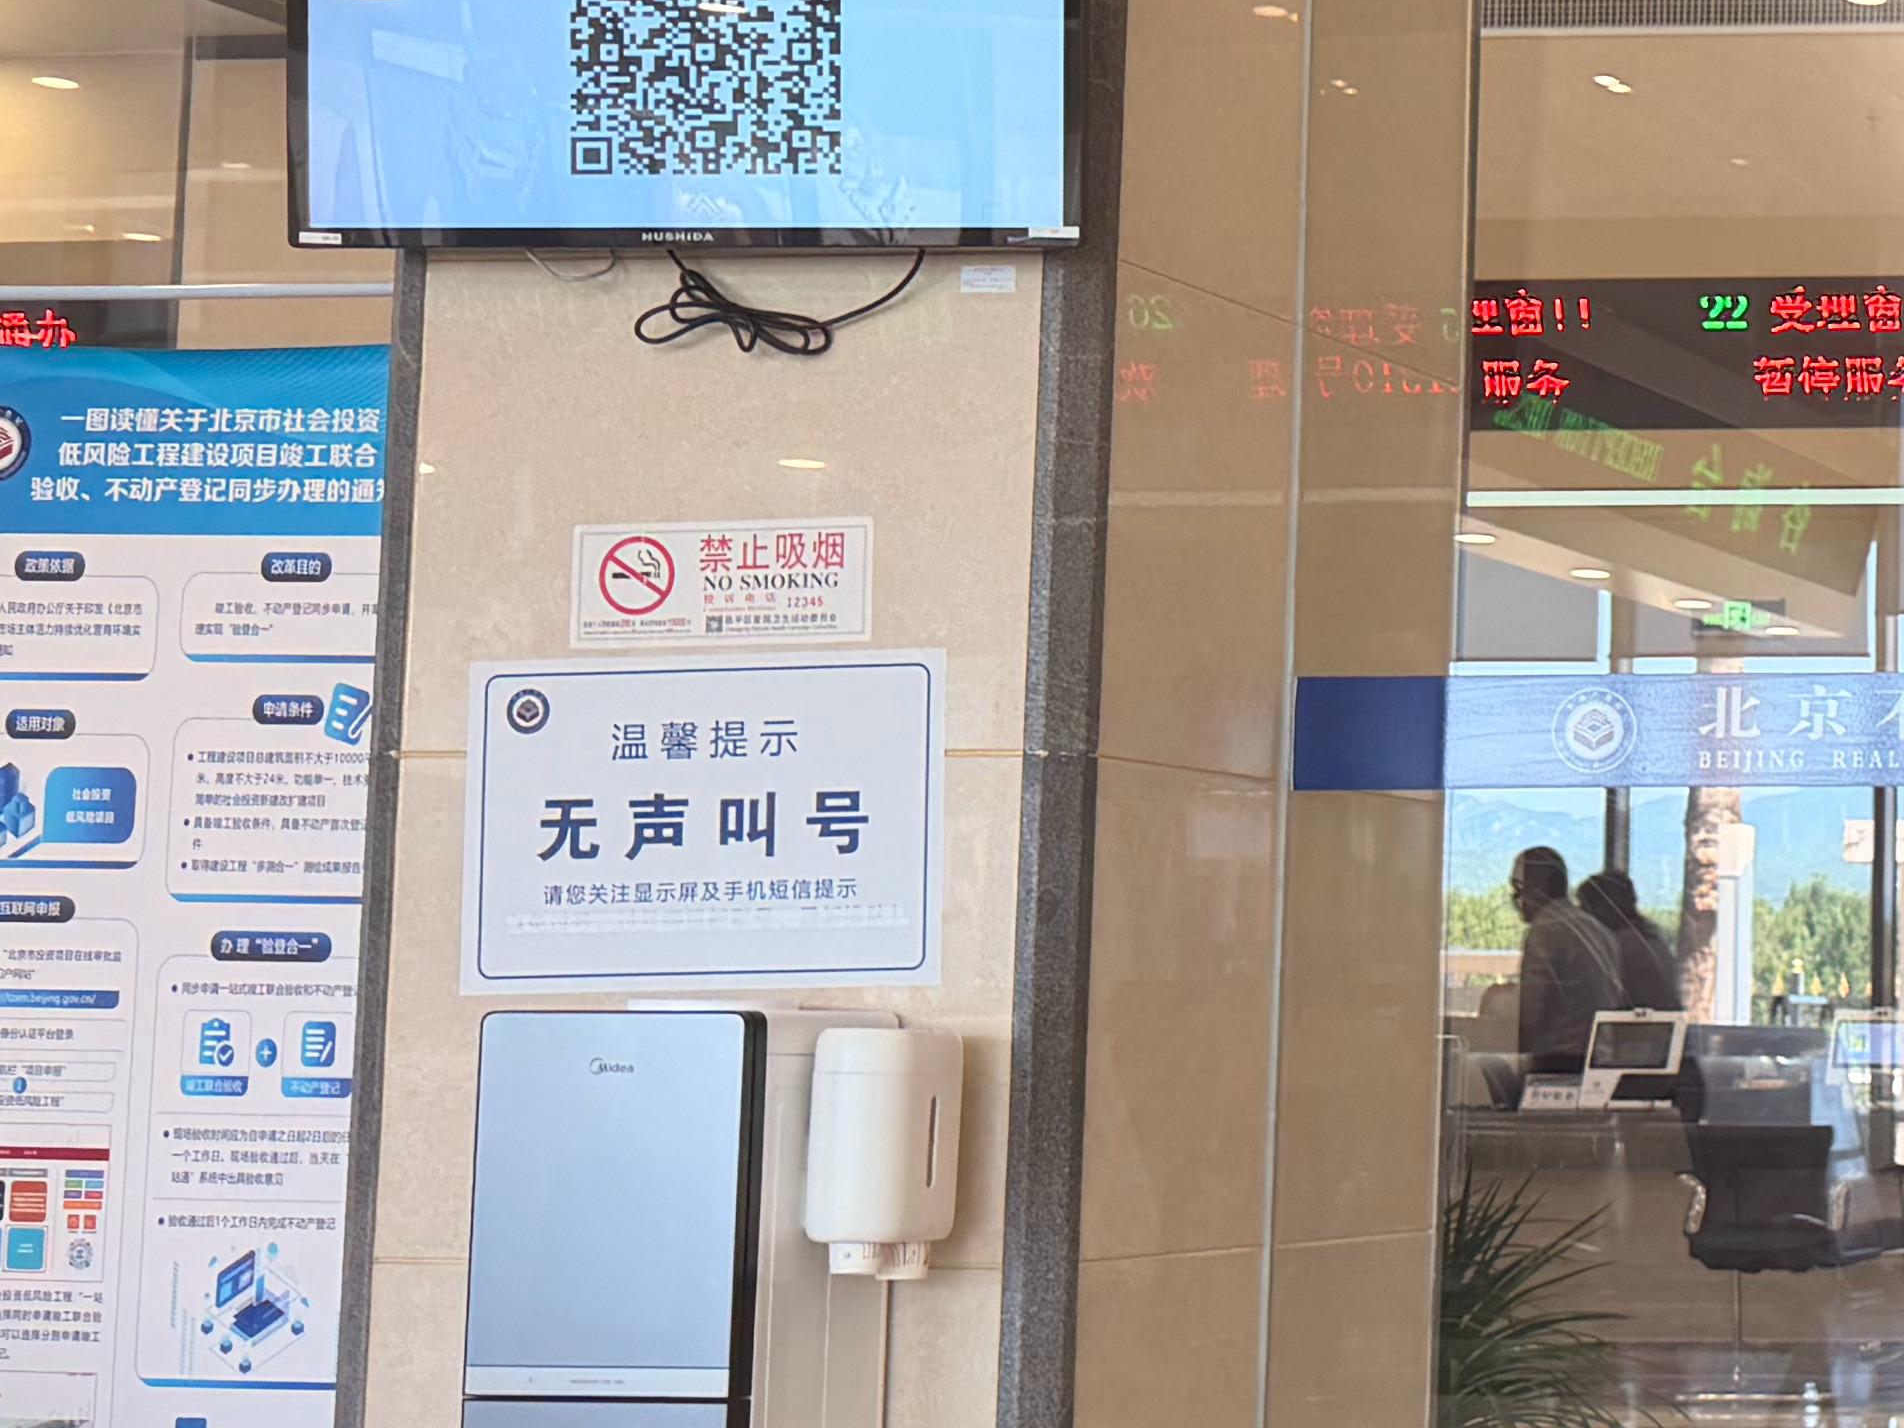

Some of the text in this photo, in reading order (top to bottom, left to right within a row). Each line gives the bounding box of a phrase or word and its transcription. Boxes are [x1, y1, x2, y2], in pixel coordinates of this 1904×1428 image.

[1700, 294, 1749, 331] 22
[61, 407, 380, 433] 一图读懂关于北京市社会投资
[59, 443, 379, 468] 低风险工程建设项目竣工联合
[700, 531, 846, 573] 禁止吸烟
[703, 572, 840, 592] NO SMOKING
[786, 595, 825, 609] 12345
[611, 719, 799, 762] 温馨提示
[1698, 749, 1807, 771] BEIJING
[1832, 749, 1903, 769] REAL
[537, 790, 870, 862] 无声叫号
[543, 877, 858, 906] 请您关注显示屏及手机短信提示
